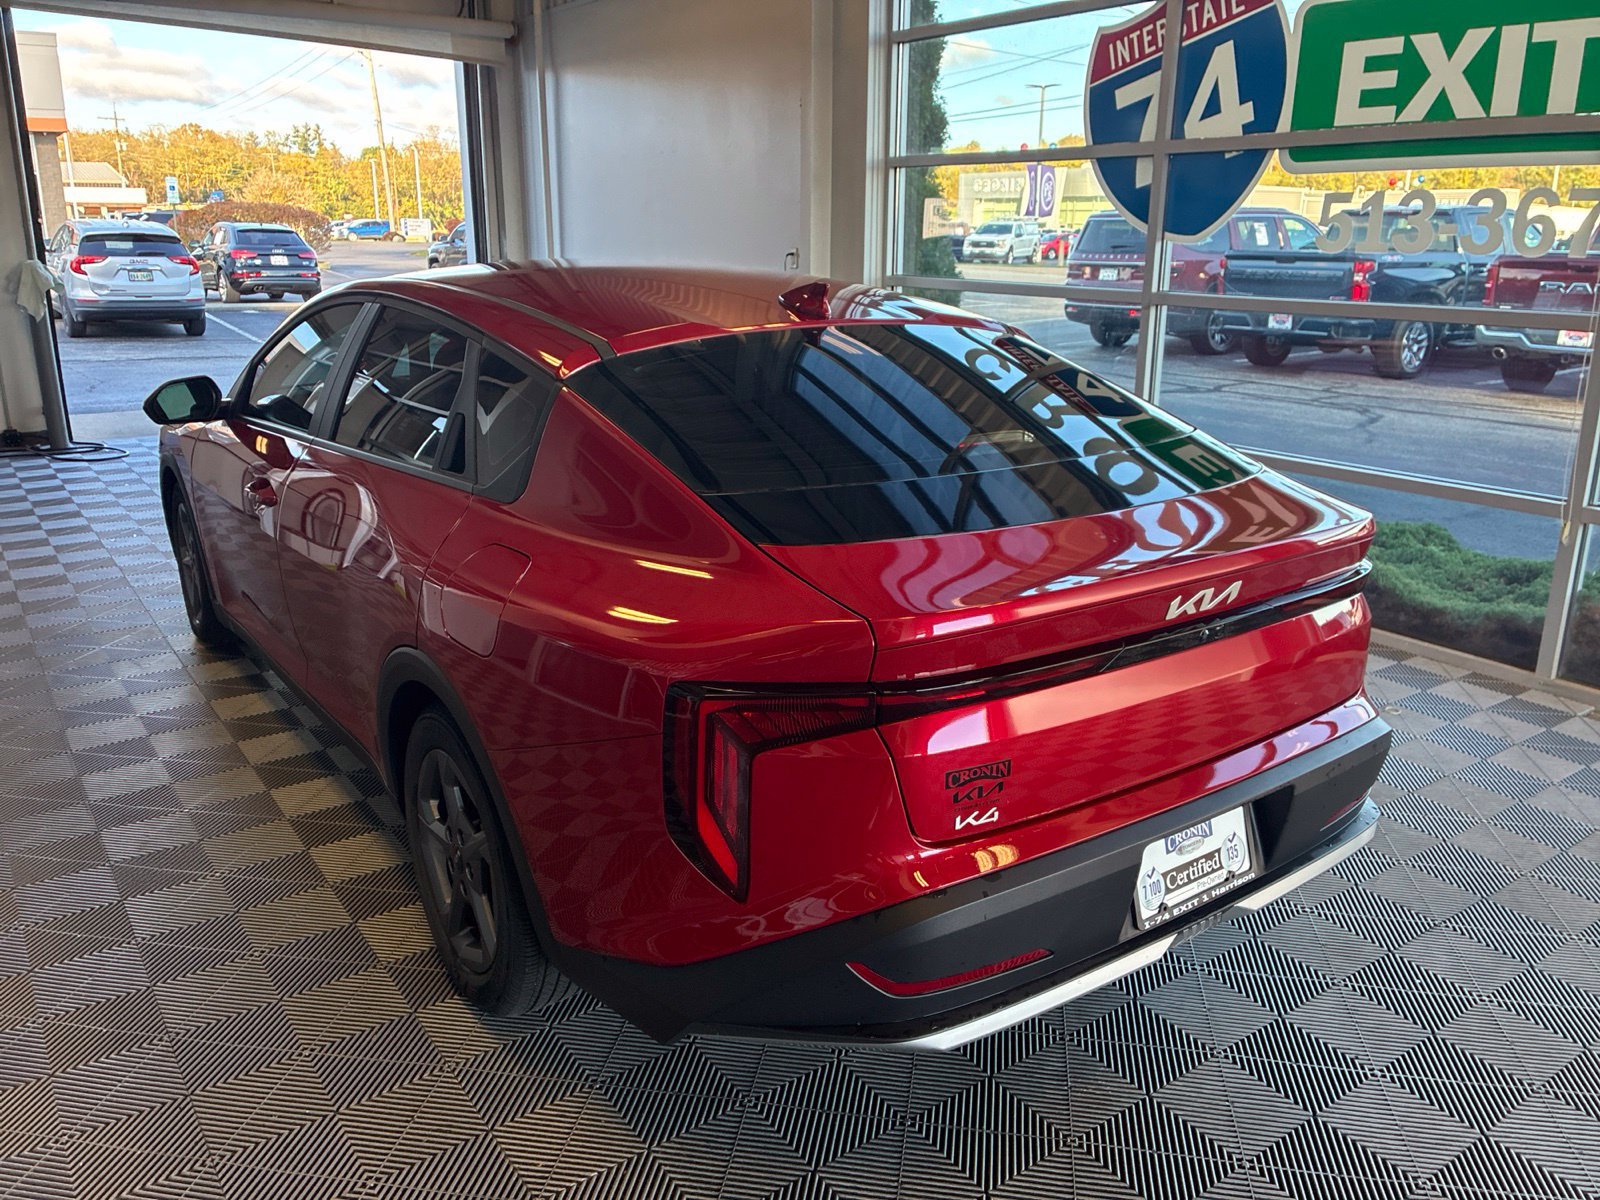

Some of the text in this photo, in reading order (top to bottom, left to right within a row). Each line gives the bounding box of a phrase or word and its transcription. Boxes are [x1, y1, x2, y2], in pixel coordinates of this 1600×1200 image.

[1334, 17, 1600, 127] EXIT
[1114, 39, 1255, 189] 74
[1165, 580, 1243, 620] KIA
[947, 761, 1010, 788] CRONIN
[952, 781, 1004, 804] KIA
[955, 806, 999, 831] K4
[1167, 821, 1211, 852] CRONIN
[1226, 843, 1239, 862] 135
[1166, 852, 1222, 889] Certified
[1144, 912, 1170, 930] I-74
[1173, 897, 1200, 917] EXIT
[1211, 872, 1256, 898] Harrison
